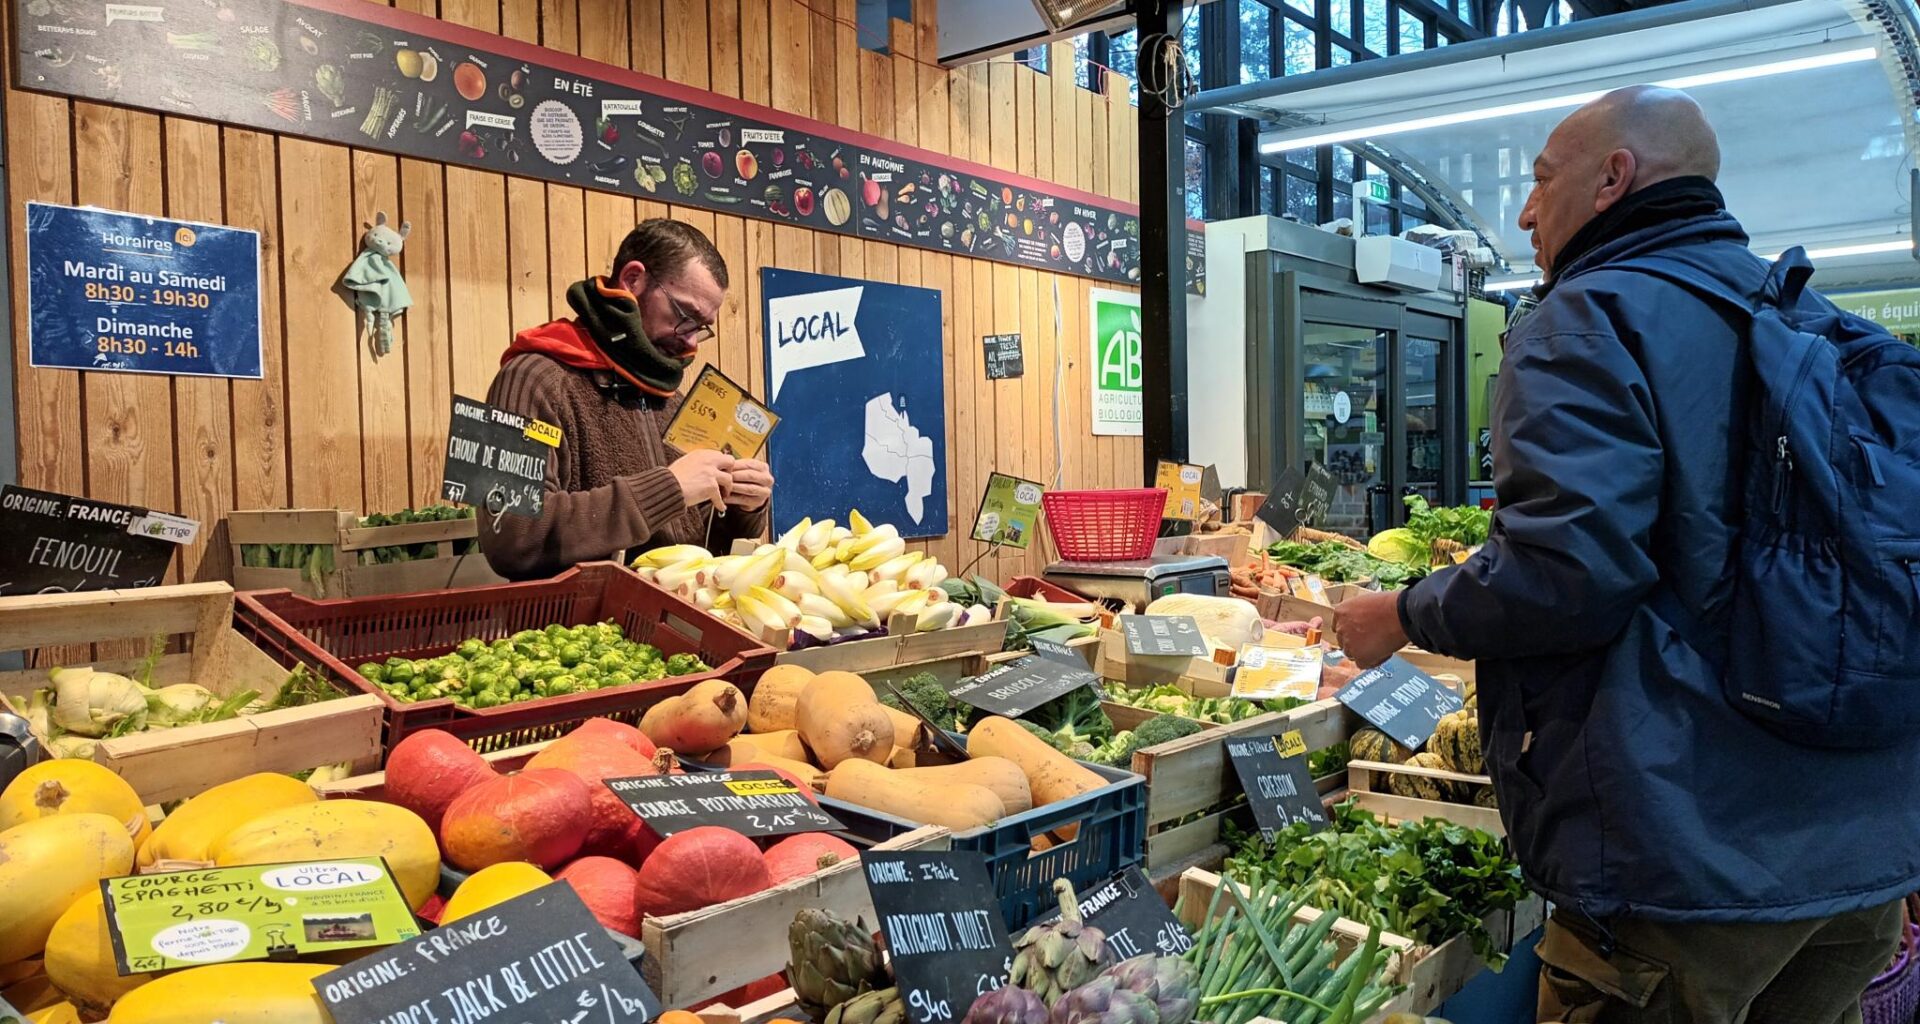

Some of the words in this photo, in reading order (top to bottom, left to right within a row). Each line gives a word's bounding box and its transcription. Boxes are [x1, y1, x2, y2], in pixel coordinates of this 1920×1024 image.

[240, 26, 270, 34] SALADE
[296, 17, 323, 38] AVOCAT
[554, 78, 569, 92] EN
[573, 79, 593, 97] ÉTÉ
[301, 90, 312, 121] CAROTTE
[604, 103, 639, 112] RATATOUILLE
[388, 108, 407, 139] ASPERGES
[469, 113, 487, 124] FRAISE
[488, 116, 493, 124] ET
[637, 120, 665, 139] COURGETTE
[744, 132, 763, 141] FRUITS
[860, 154, 871, 165] EN
[872, 158, 904, 174] AUTOMNE
[102, 231, 173, 252] Horaires
[64, 260, 125, 282] Mardi
[130, 269, 153, 284] au
[159, 270, 226, 292] Samedi
[85, 283, 134, 301] 8h30
[152, 289, 209, 309] 19h30
[1882, 301, 1920, 322] équi
[97, 317, 193, 339] Dimanche
[778, 311, 850, 348] LOCAL
[97, 336, 146, 355] 8h30
[165, 342, 198, 358] 14h
[1101, 329, 1143, 388] AB
[1098, 393, 1142, 406] AGRICULTU
[454, 402, 488, 423] ORIGINE:
[491, 409, 525, 430] FRANCE
[737, 407, 765, 433] LOCAL
[527, 421, 559, 440] OCAL!
[448, 436, 479, 465] CHOUX
[482, 445, 496, 469] DE
[498, 449, 546, 481] BRUXELLES
[1182, 471, 1199, 480] LOCAL
[1016, 489, 1037, 503] LOCAL
[2, 493, 62, 518] ORIGINE:
[67, 504, 132, 526] FRANCE
[28, 536, 122, 579] FENOUIL
[975, 664, 1014, 684] ESPAGNE
[1354, 668, 1385, 690] FRANCE
[987, 674, 1048, 700] BROCOLI
[1365, 698, 1402, 726] COURGE
[1390, 675, 1430, 707] PATIDOU
[611, 781, 673, 791] ORIGINE:
[675, 773, 733, 787] FRANCE
[1257, 772, 1298, 799] CRESSON
[631, 799, 697, 819] COURGE
[700, 793, 808, 813] POTIMARRON
[121, 870, 223, 890] COURGE
[276, 870, 372, 888] LOCAL
[869, 860, 913, 884] ORIGINE:
[919, 860, 960, 881] Italie
[172, 900, 229, 922] 2,80
[1078, 882, 1122, 919] FRANCE
[886, 912, 953, 957] ARTICHAUT
[951, 910, 996, 950] VIOLET
[1106, 927, 1141, 960] TTE
[326, 957, 416, 1005] ORIGINE:
[415, 914, 508, 964] FRANCE
[442, 974, 506, 1024] JACK
[500, 960, 538, 1005] BE
[530, 932, 606, 989] LITTLE
